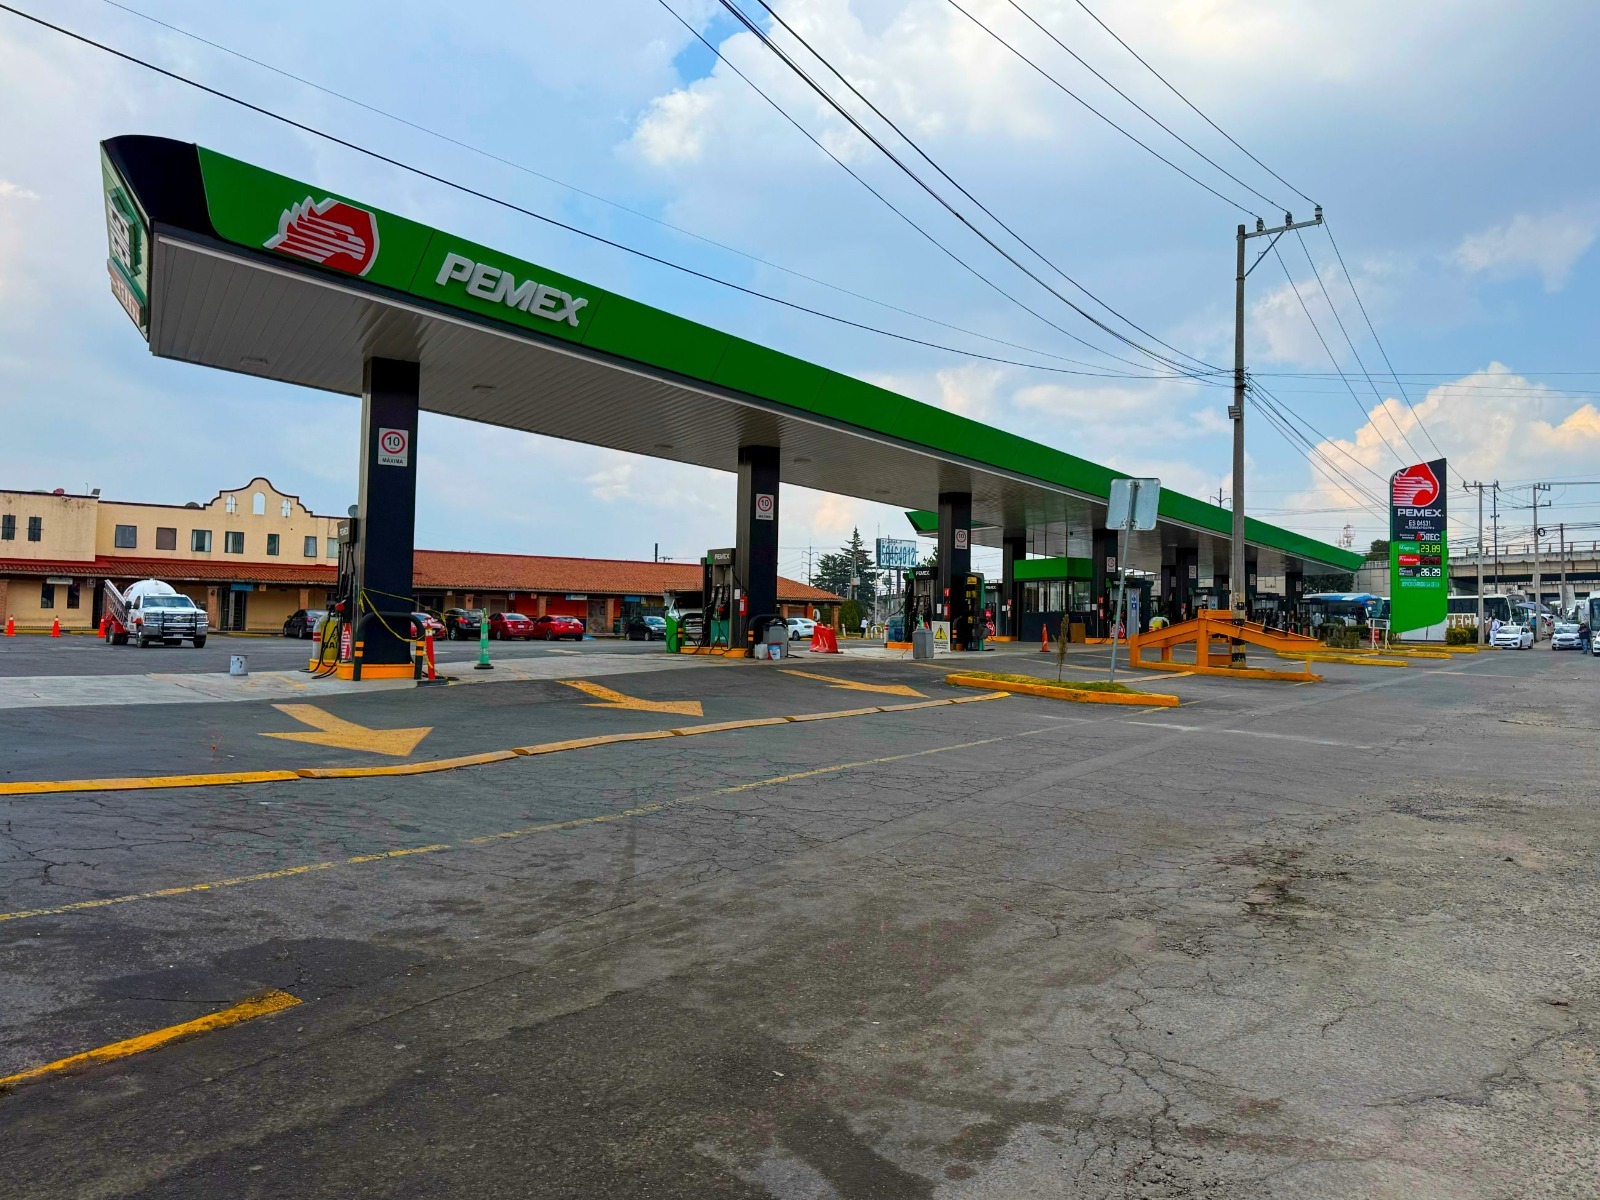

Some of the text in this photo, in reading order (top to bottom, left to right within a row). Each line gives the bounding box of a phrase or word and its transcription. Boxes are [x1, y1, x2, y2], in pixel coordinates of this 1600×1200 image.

[435, 252, 589, 327] PEMEX
[386, 436, 400, 447] 10
[760, 499, 770, 507] 10
[1397, 508, 1442, 517] PEMEX
[1420, 544, 1441, 553] 23.89
[1420, 567, 1441, 577] 26.29
